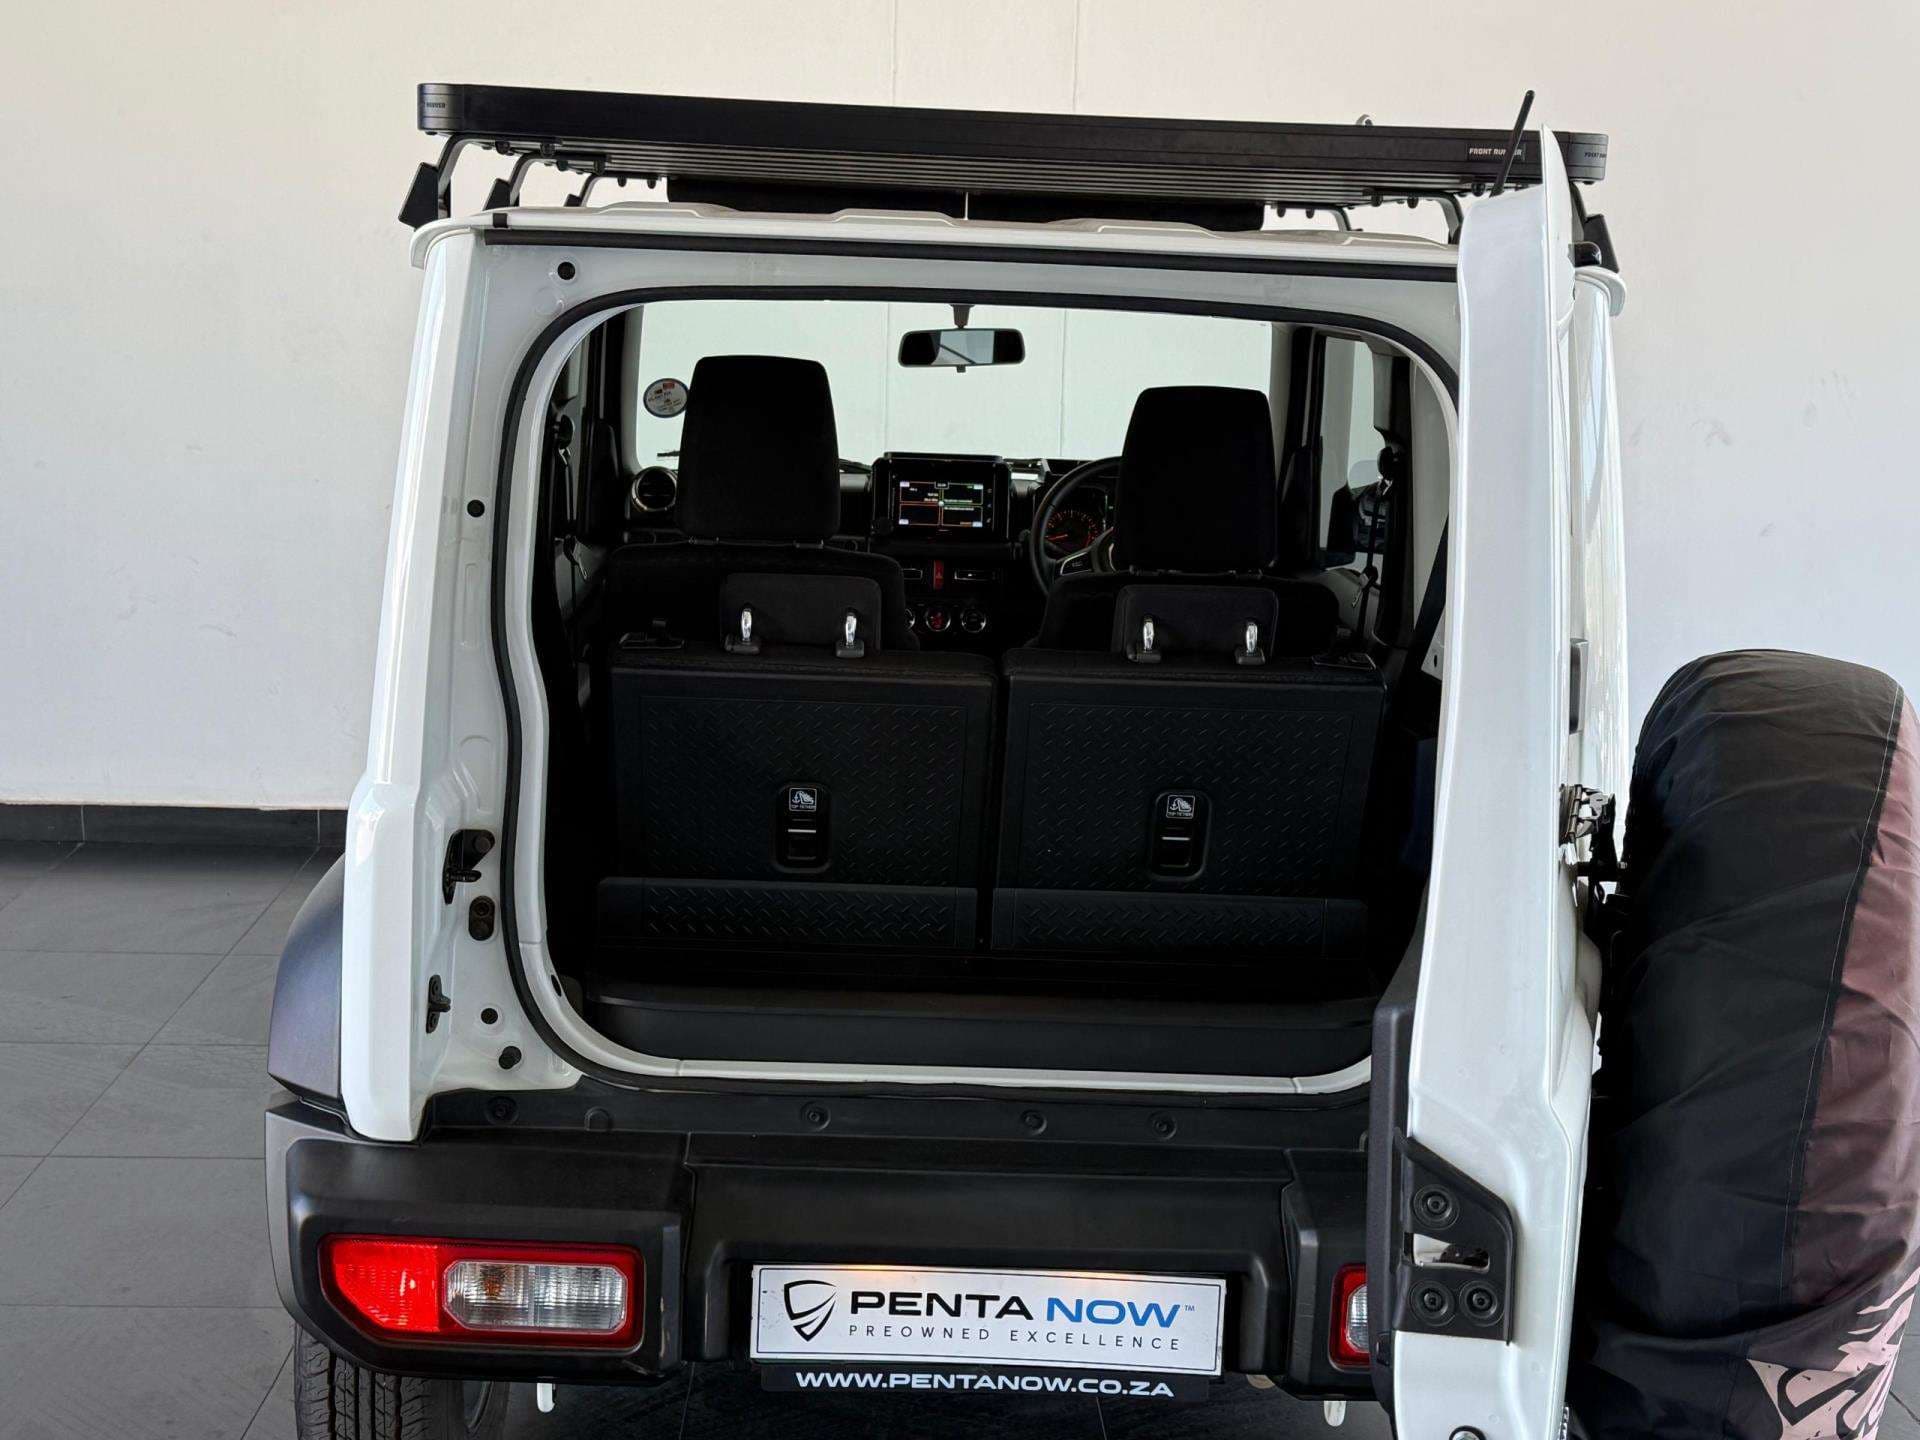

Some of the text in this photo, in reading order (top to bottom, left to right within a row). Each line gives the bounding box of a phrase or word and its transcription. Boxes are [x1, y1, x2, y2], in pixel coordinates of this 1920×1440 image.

[1468, 147, 1492, 156] FRONT
[851, 1290, 1034, 1321] PENTA
[1046, 1297, 1181, 1328] NOW
[848, 1325, 1181, 1351] PREOWNED EXCELLENCE
[795, 1372, 1175, 1398] WWW.PENTANOW.CO.ZA
